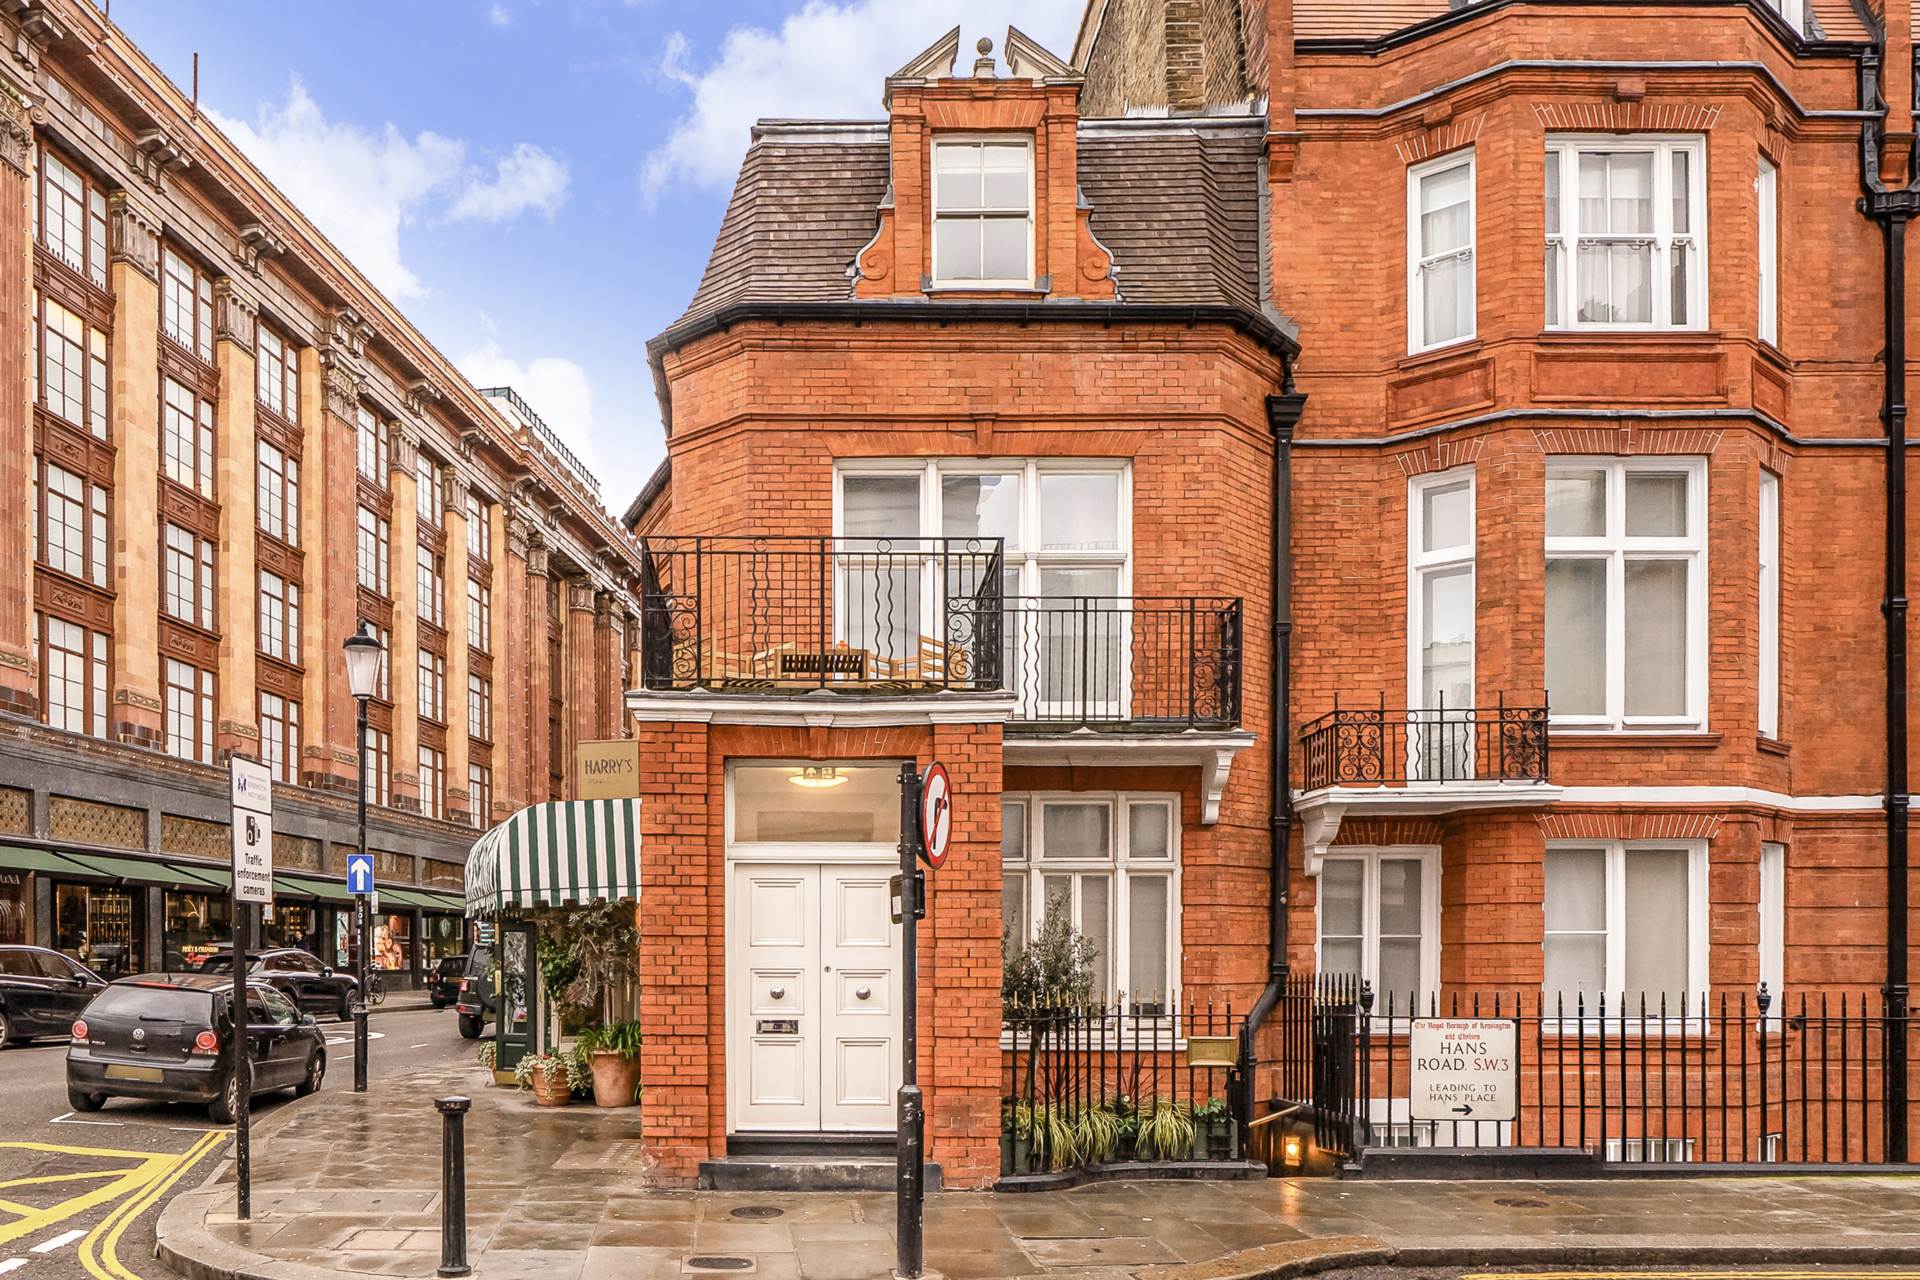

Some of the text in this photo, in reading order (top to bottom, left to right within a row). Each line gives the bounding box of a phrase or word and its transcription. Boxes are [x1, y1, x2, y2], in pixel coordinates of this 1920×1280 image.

[585, 759, 632, 774] HARRY'S
[244, 853, 263, 867] Traffic
[237, 868, 271, 883] enforcement
[242, 885, 266, 896] cameras
[1446, 1022, 1470, 1031] Borough
[1471, 1022, 1478, 1030] of
[1480, 1022, 1511, 1031] Kensington
[1440, 1042, 1487, 1055] HANS
[1473, 1058, 1509, 1072] S.W.3
[1429, 1083, 1497, 1092] LEADING TO
[1429, 1093, 1496, 1102] HANS PLACE
